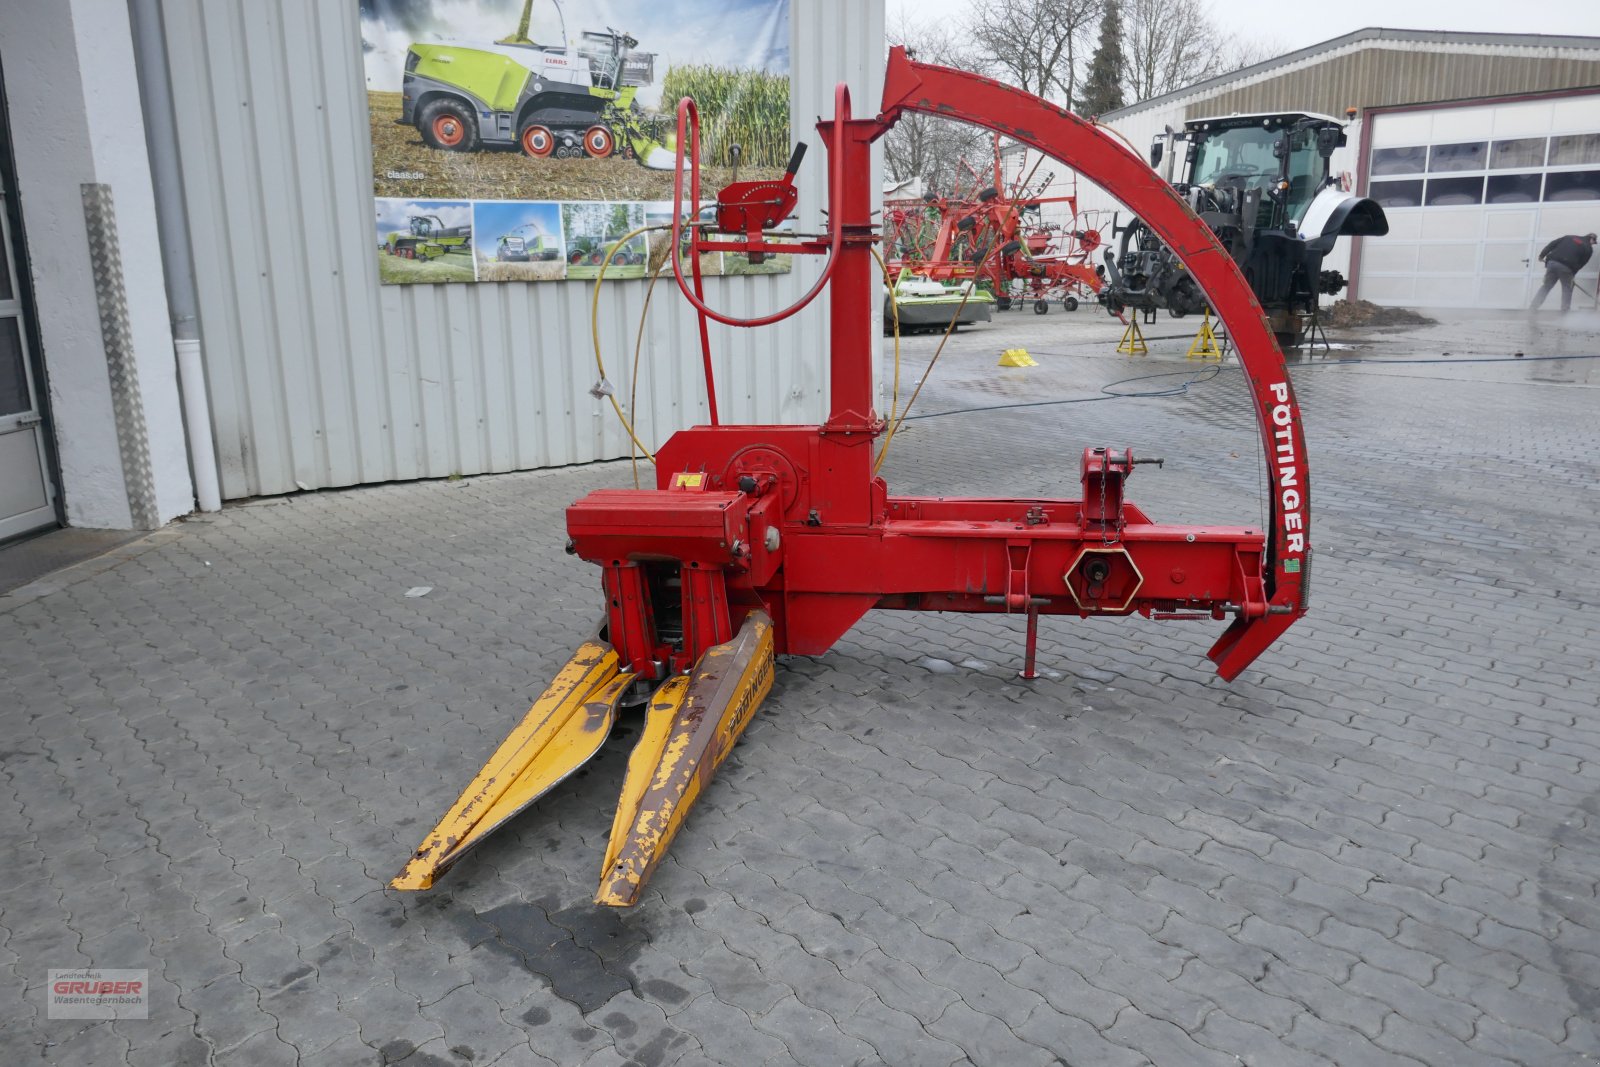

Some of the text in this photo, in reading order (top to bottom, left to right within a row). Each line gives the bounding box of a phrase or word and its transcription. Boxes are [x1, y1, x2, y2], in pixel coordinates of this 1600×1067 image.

[545, 58, 567, 66] CLAAS
[387, 171, 424, 180] claas.de
[1269, 382, 1304, 553] PÖTTINGER
